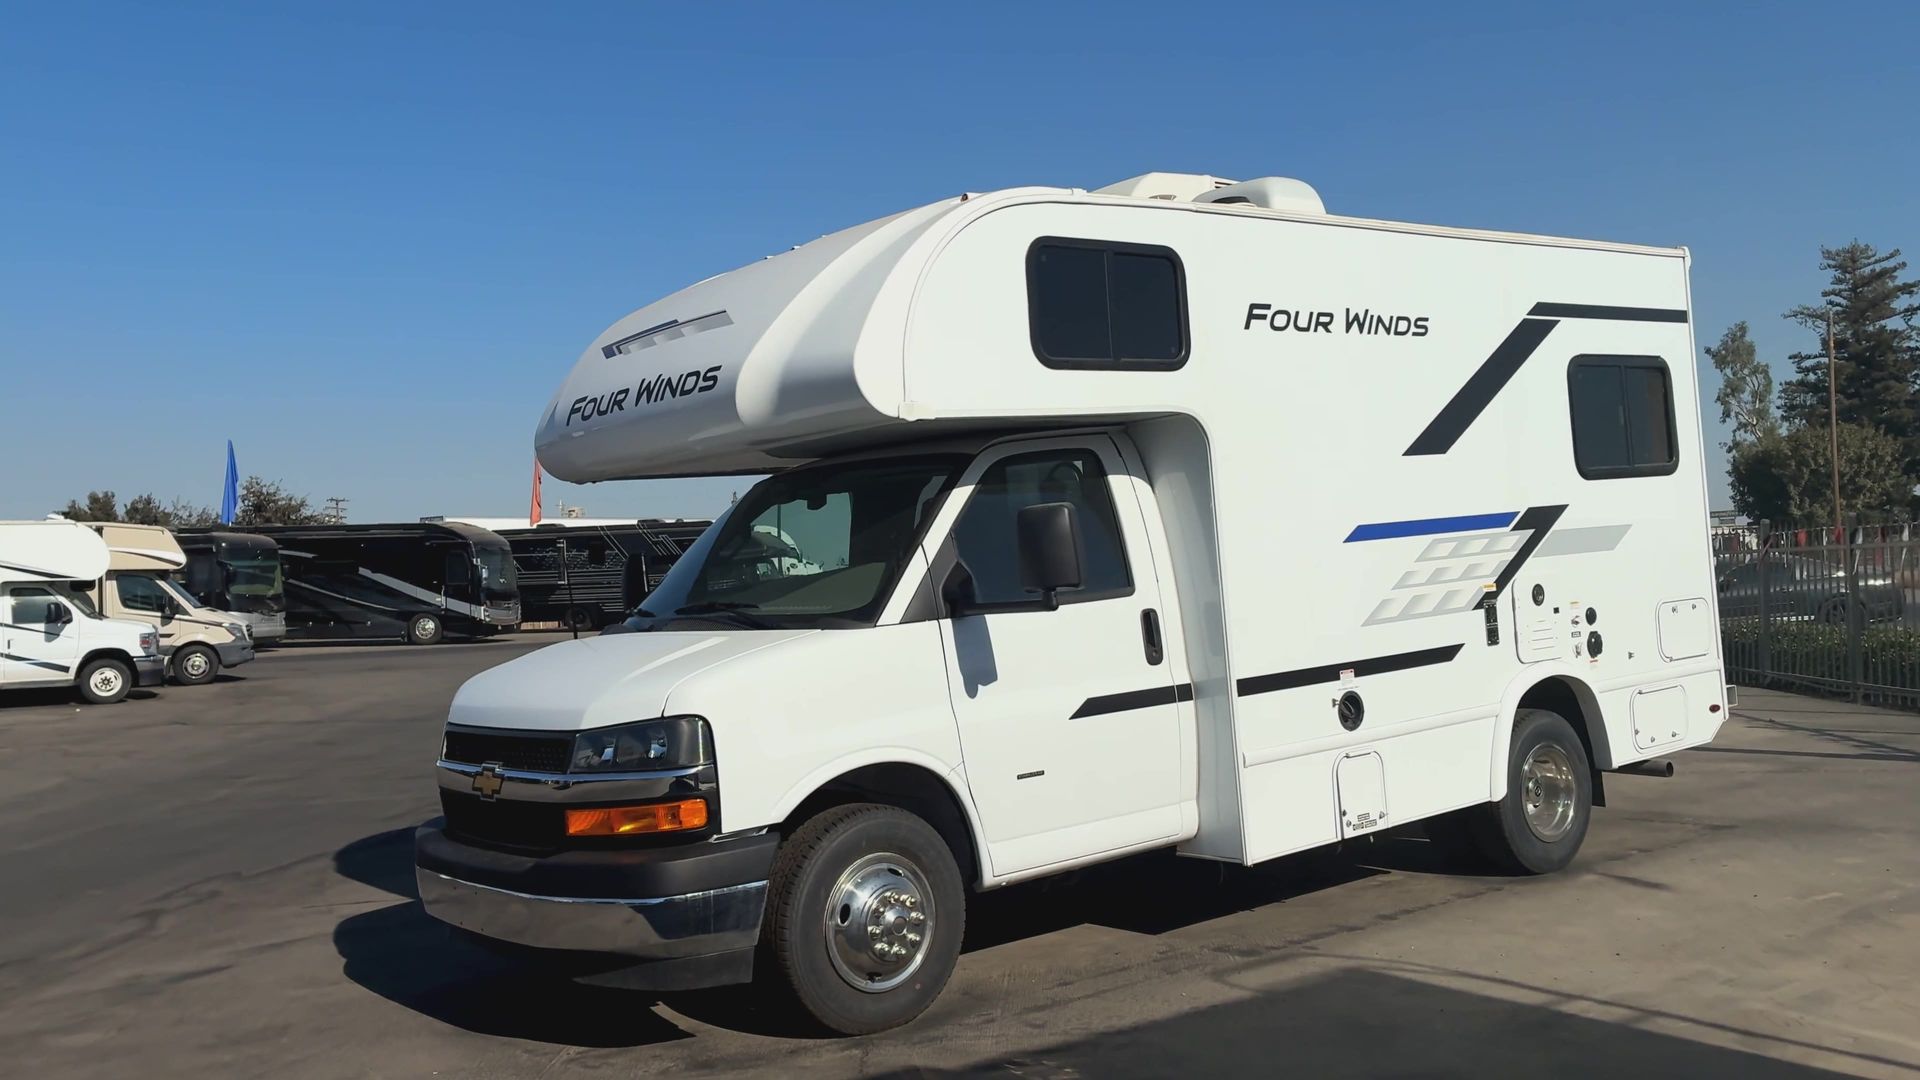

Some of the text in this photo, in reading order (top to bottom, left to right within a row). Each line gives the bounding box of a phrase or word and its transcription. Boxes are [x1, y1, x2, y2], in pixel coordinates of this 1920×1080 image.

[1244, 303, 1429, 336] FOUR WINDS
[566, 365, 722, 426] FOUR WINDS
